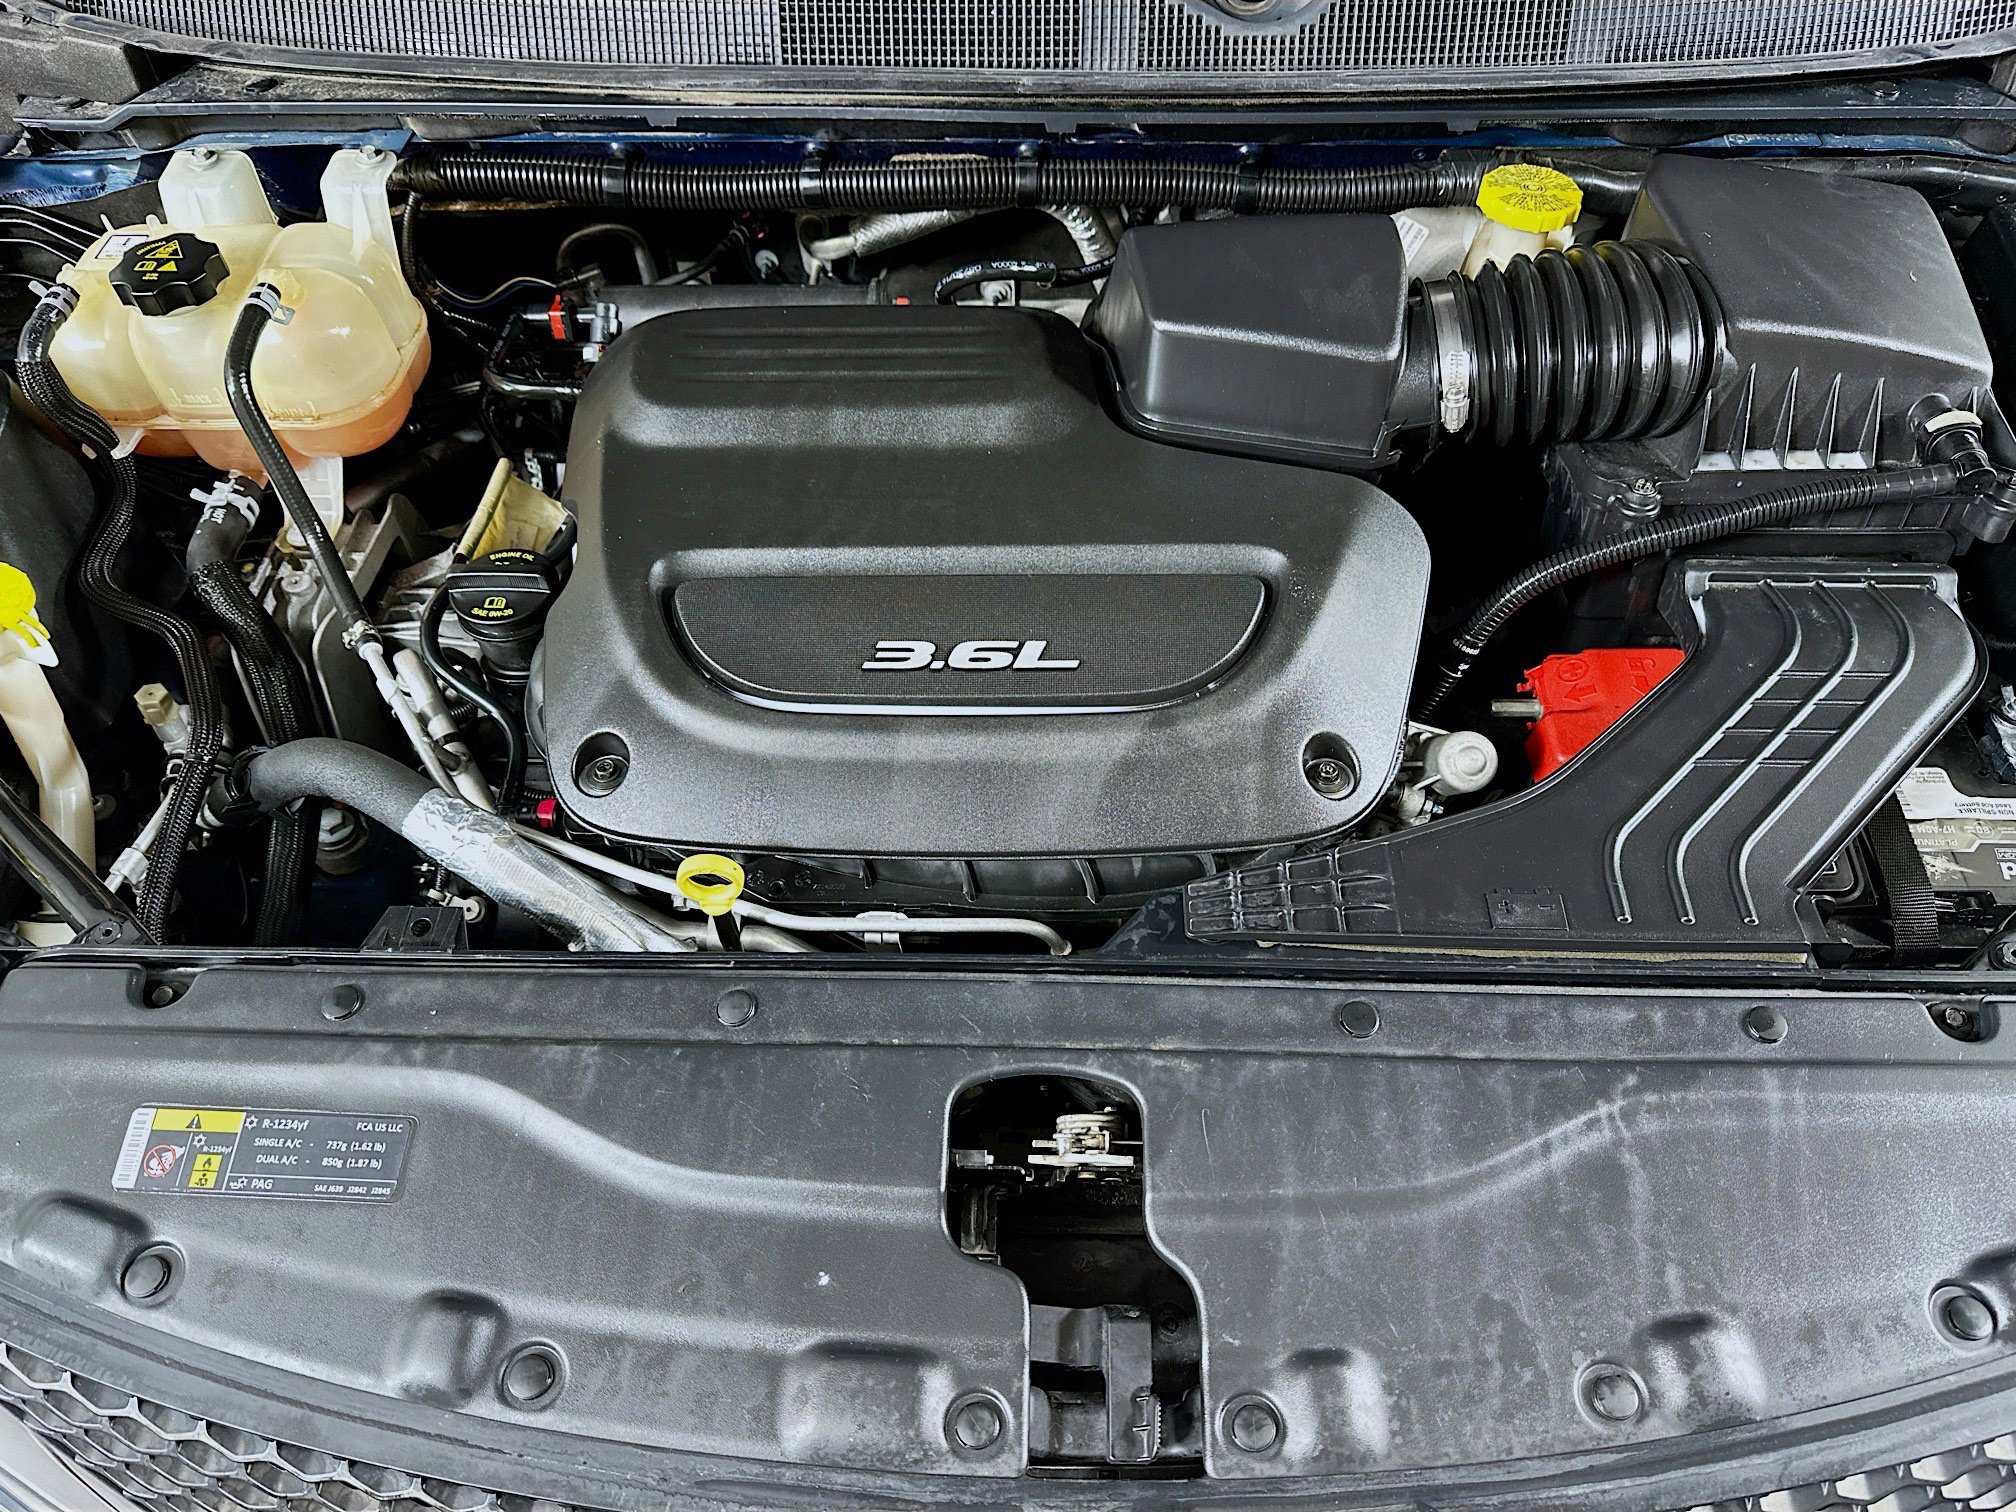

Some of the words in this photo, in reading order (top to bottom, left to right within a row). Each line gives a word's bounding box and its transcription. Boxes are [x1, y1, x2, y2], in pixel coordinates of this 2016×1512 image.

[489, 551, 522, 560] ENGINE
[522, 553, 535, 561] OIL
[471, 608, 488, 617] SAE
[489, 609, 513, 617] 0W-20
[862, 640, 1080, 669] 3.6L
[1917, 825, 1956, 833] H7-AGM
[262, 1119, 309, 1131] R-1234yf
[356, 1122, 373, 1131] FCA
[375, 1123, 387, 1132] US
[388, 1123, 403, 1132] LLC
[203, 1145, 233, 1154] R-1234yf
[254, 1137, 284, 1147] SINGLE
[285, 1138, 303, 1149] A/C
[326, 1141, 347, 1152] 737g
[351, 1141, 372, 1152] (1.62
[374, 1142, 386, 1153] lb)
[256, 1155, 279, 1163] DUAL
[280, 1155, 298, 1165] A/C
[322, 1158, 343, 1169] 850g
[347, 1158, 369, 1169] (1.87
[370, 1159, 382, 1170] lb)
[251, 1178, 273, 1189] PAG
